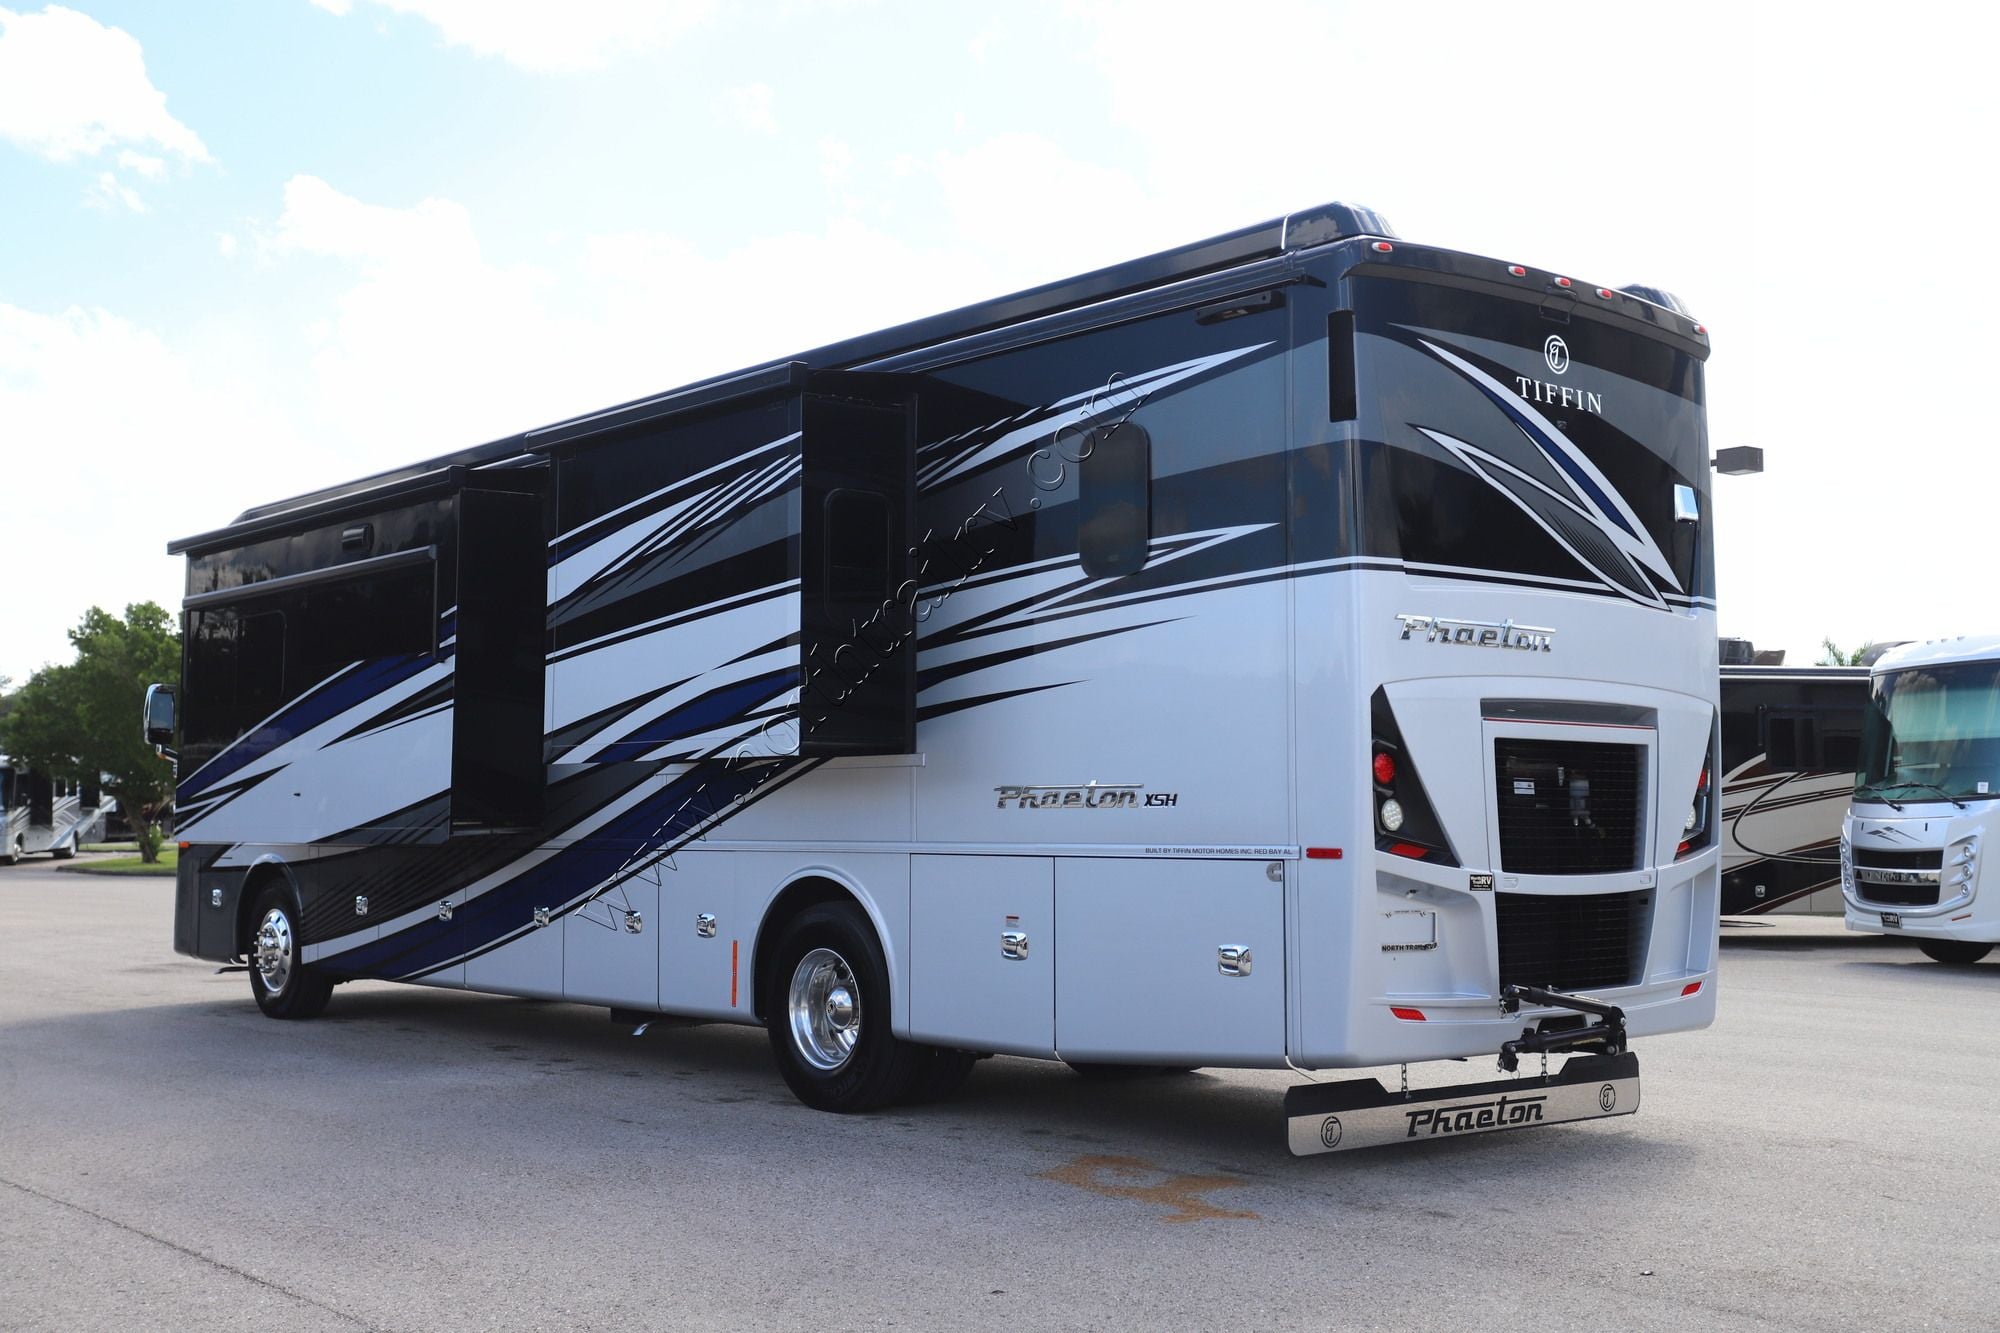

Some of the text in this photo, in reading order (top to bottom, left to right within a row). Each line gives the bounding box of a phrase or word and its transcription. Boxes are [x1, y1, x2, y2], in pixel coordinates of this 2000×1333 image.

[1516, 376, 1602, 414] TIFFIN
[1395, 614, 1556, 652] Phaeton
[994, 780, 1178, 809] Phaeton XSH
[1481, 876, 1492, 885] RV
[1406, 1096, 1547, 1137] Phaeton
